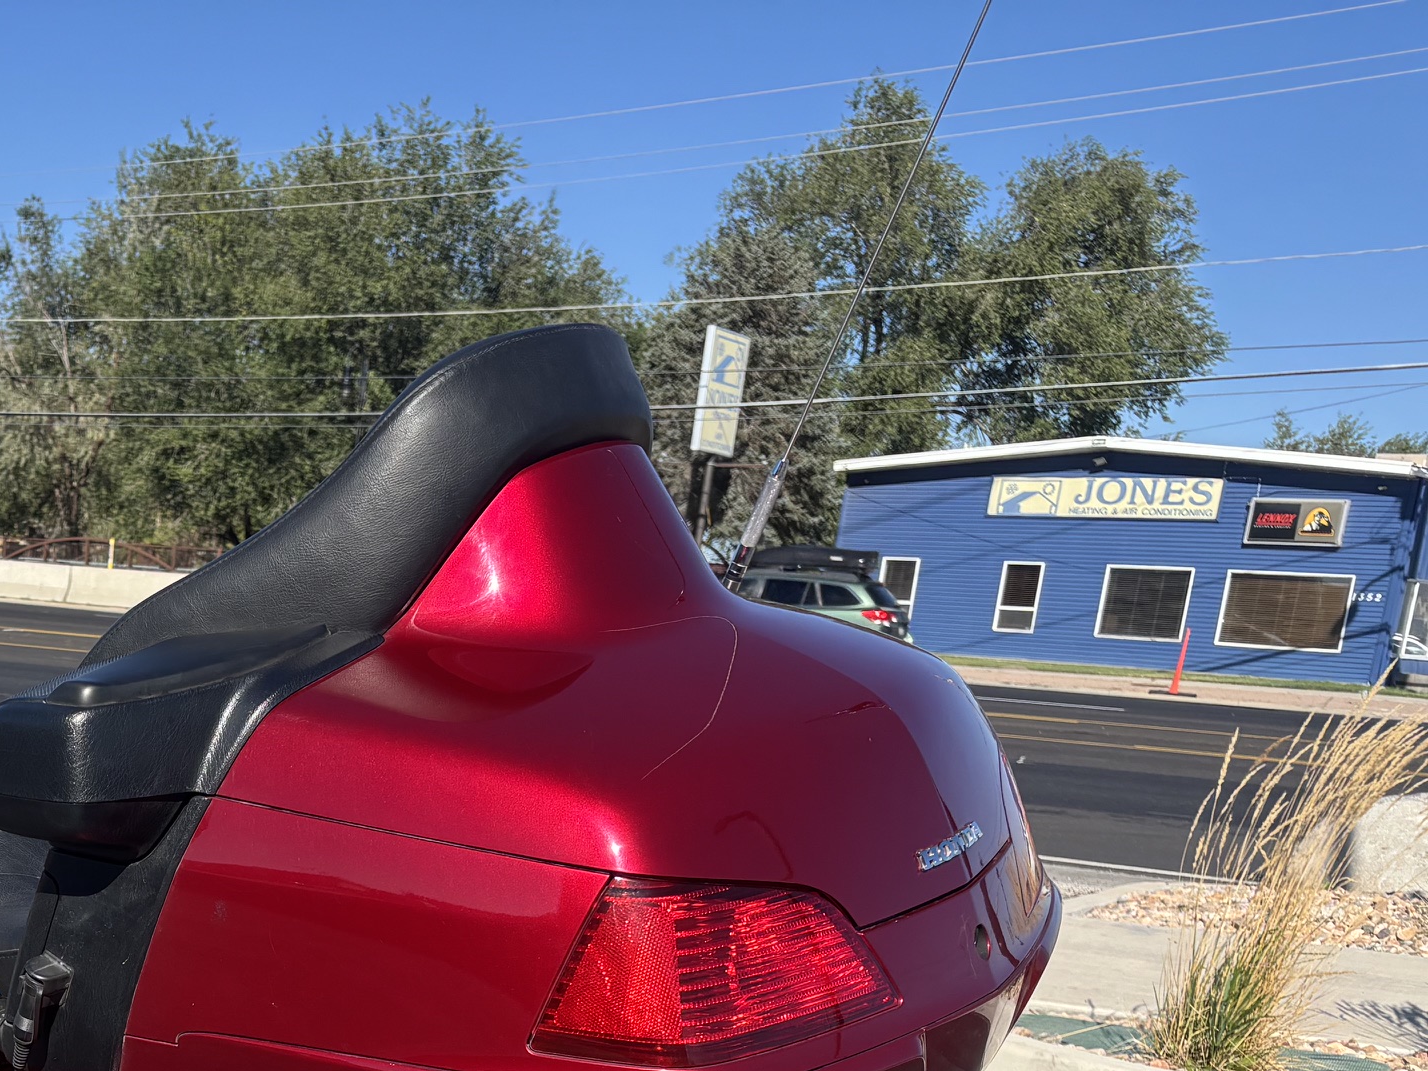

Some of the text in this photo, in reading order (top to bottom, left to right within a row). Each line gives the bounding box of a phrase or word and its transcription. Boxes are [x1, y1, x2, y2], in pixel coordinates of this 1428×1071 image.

[1074, 478, 1214, 506] JONES
[1068, 506, 1214, 517] HEATING & AIR CONDITIONING
[1256, 512, 1297, 524] LENNOX
[915, 820, 983, 872] HONDA
